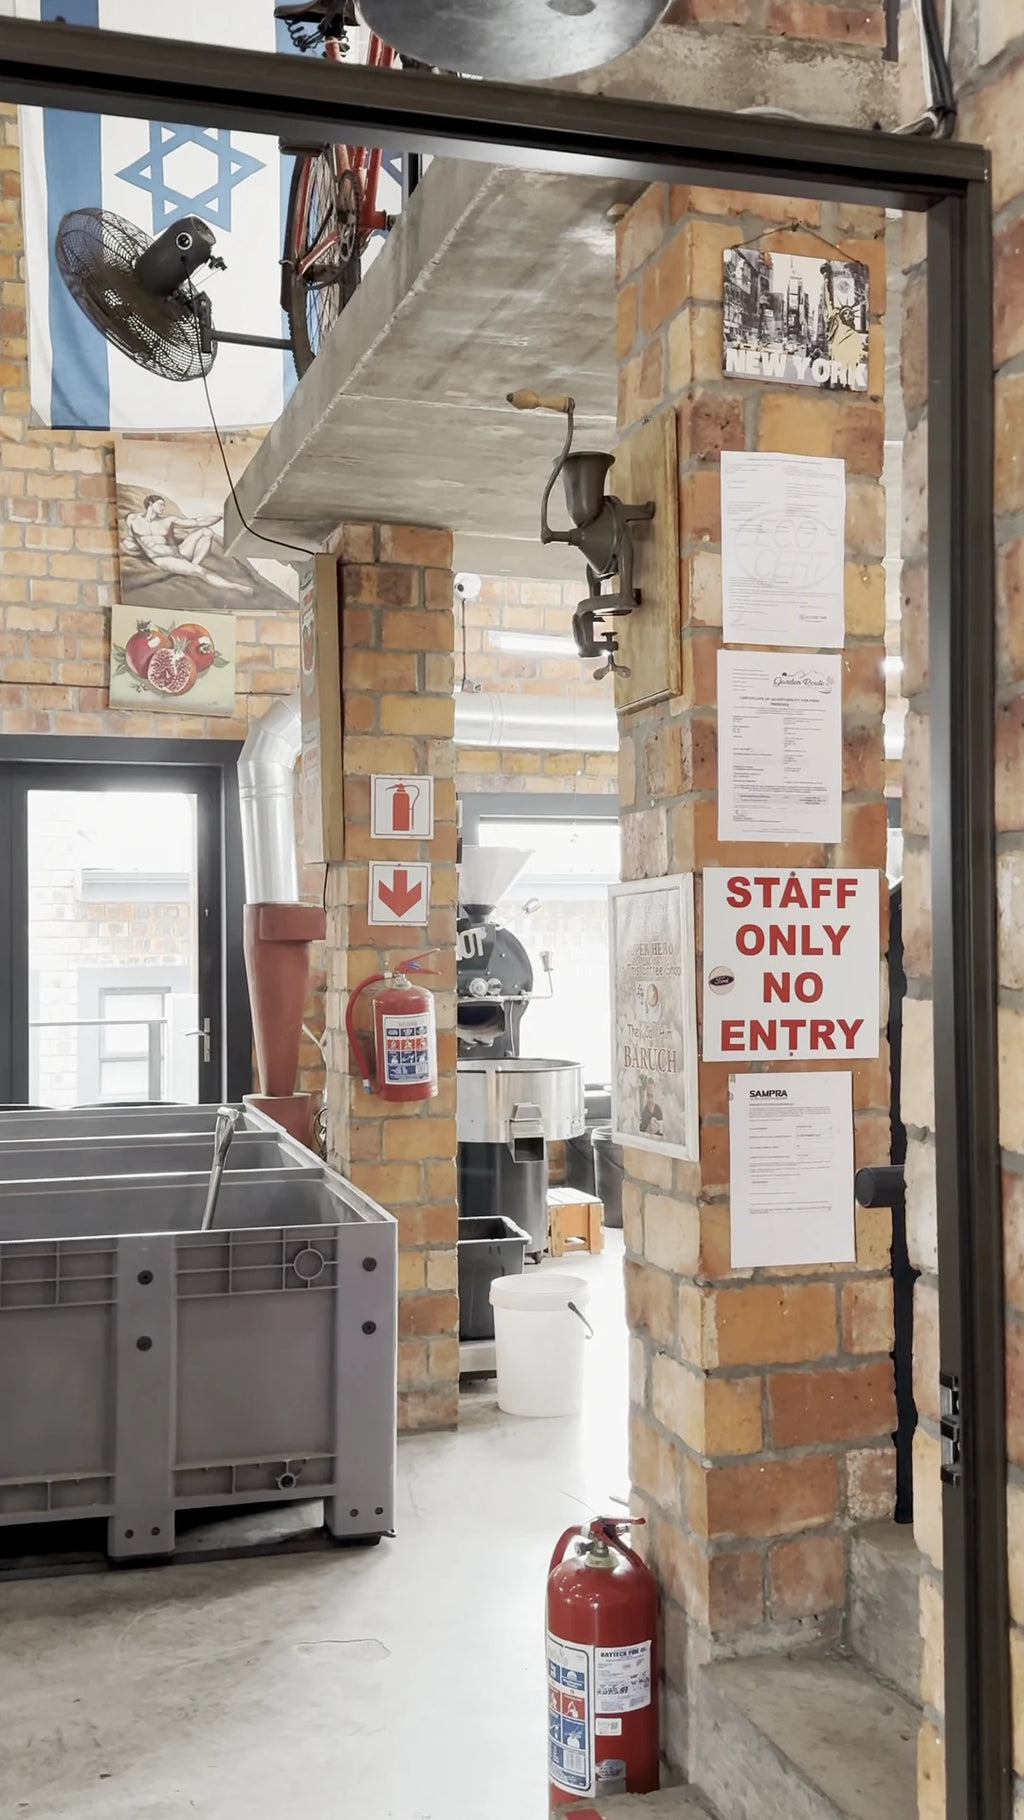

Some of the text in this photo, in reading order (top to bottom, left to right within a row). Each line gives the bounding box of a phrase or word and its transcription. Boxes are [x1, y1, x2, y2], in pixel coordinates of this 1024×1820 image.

[725, 348, 867, 389] NEW YORK
[753, 549, 829, 581] CERT
[773, 676, 801, 688] Garden
[802, 677, 825, 689] Route
[726, 876, 858, 909] STAFF
[651, 941, 674, 956] HERO
[735, 924, 851, 956] ONLY
[763, 971, 824, 1003] NO
[721, 1018, 865, 1051] ENTRY
[623, 1045, 677, 1073] BARUCH
[749, 1089, 788, 1098] SAMPRA
